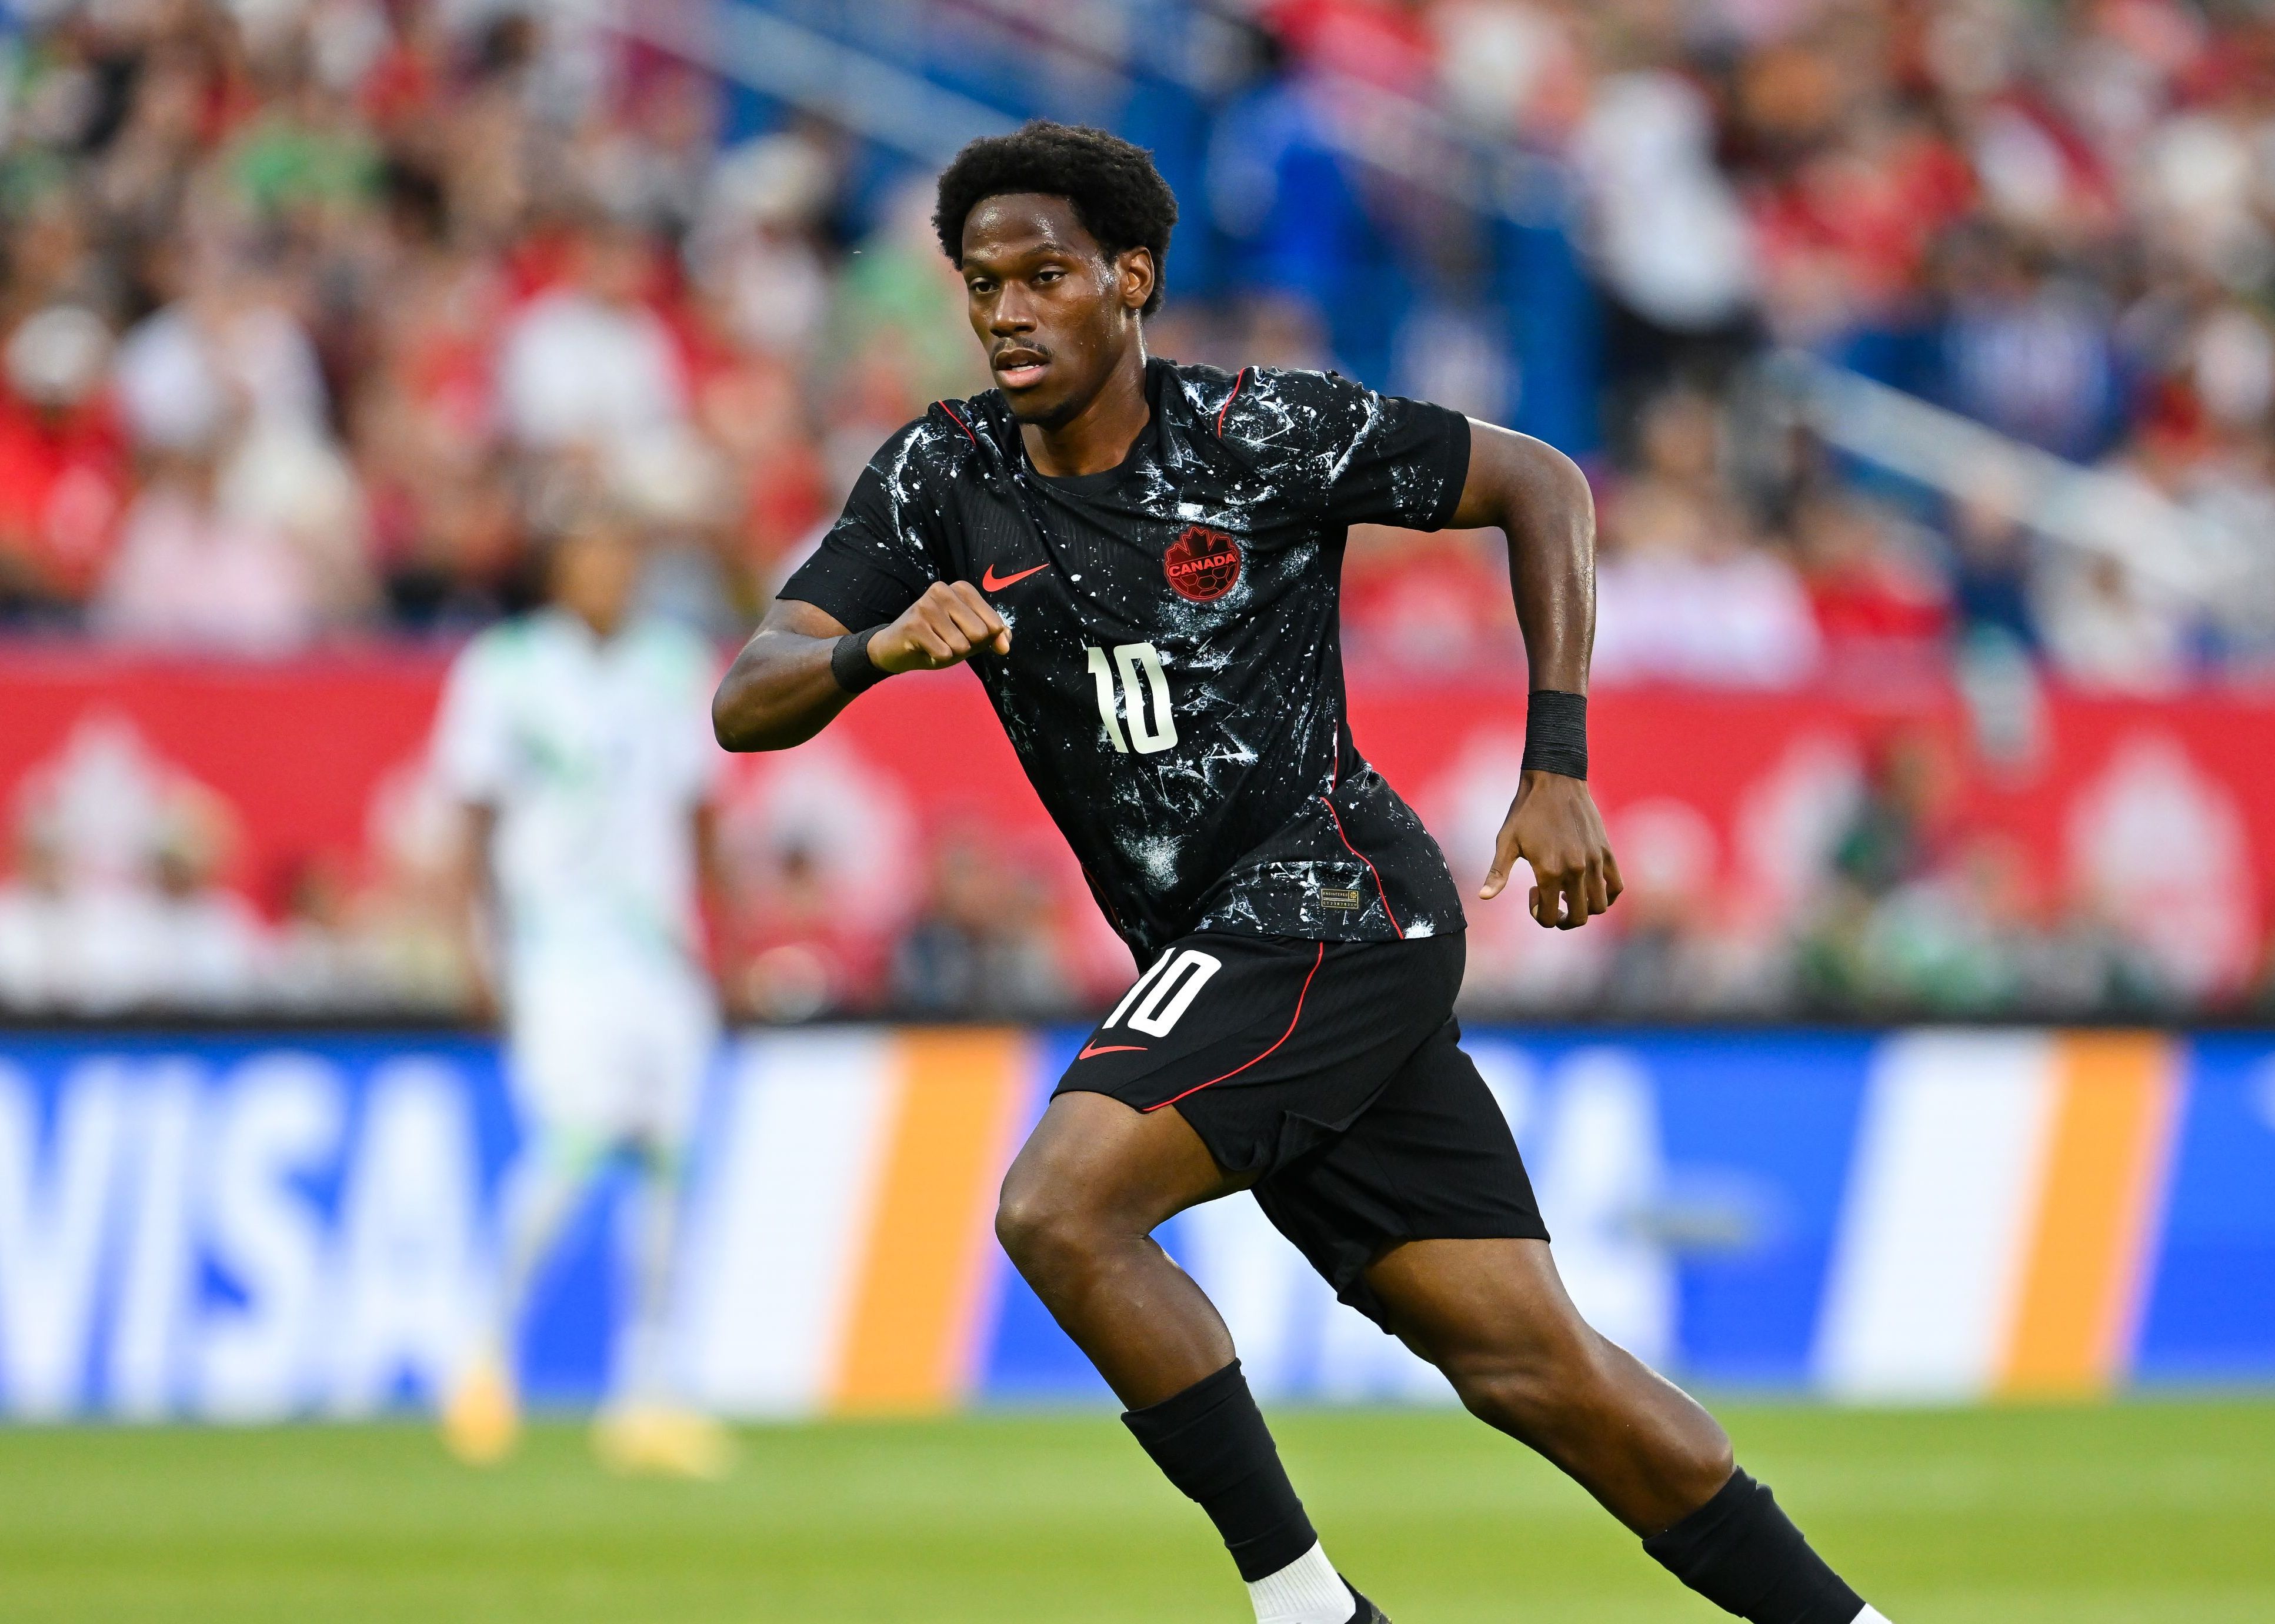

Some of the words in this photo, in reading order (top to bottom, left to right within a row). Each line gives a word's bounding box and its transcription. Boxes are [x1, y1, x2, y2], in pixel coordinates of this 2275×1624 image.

[1169, 553, 1237, 577] CANADA
[1088, 642, 1178, 754] 10
[1102, 947, 1222, 1038] 10
